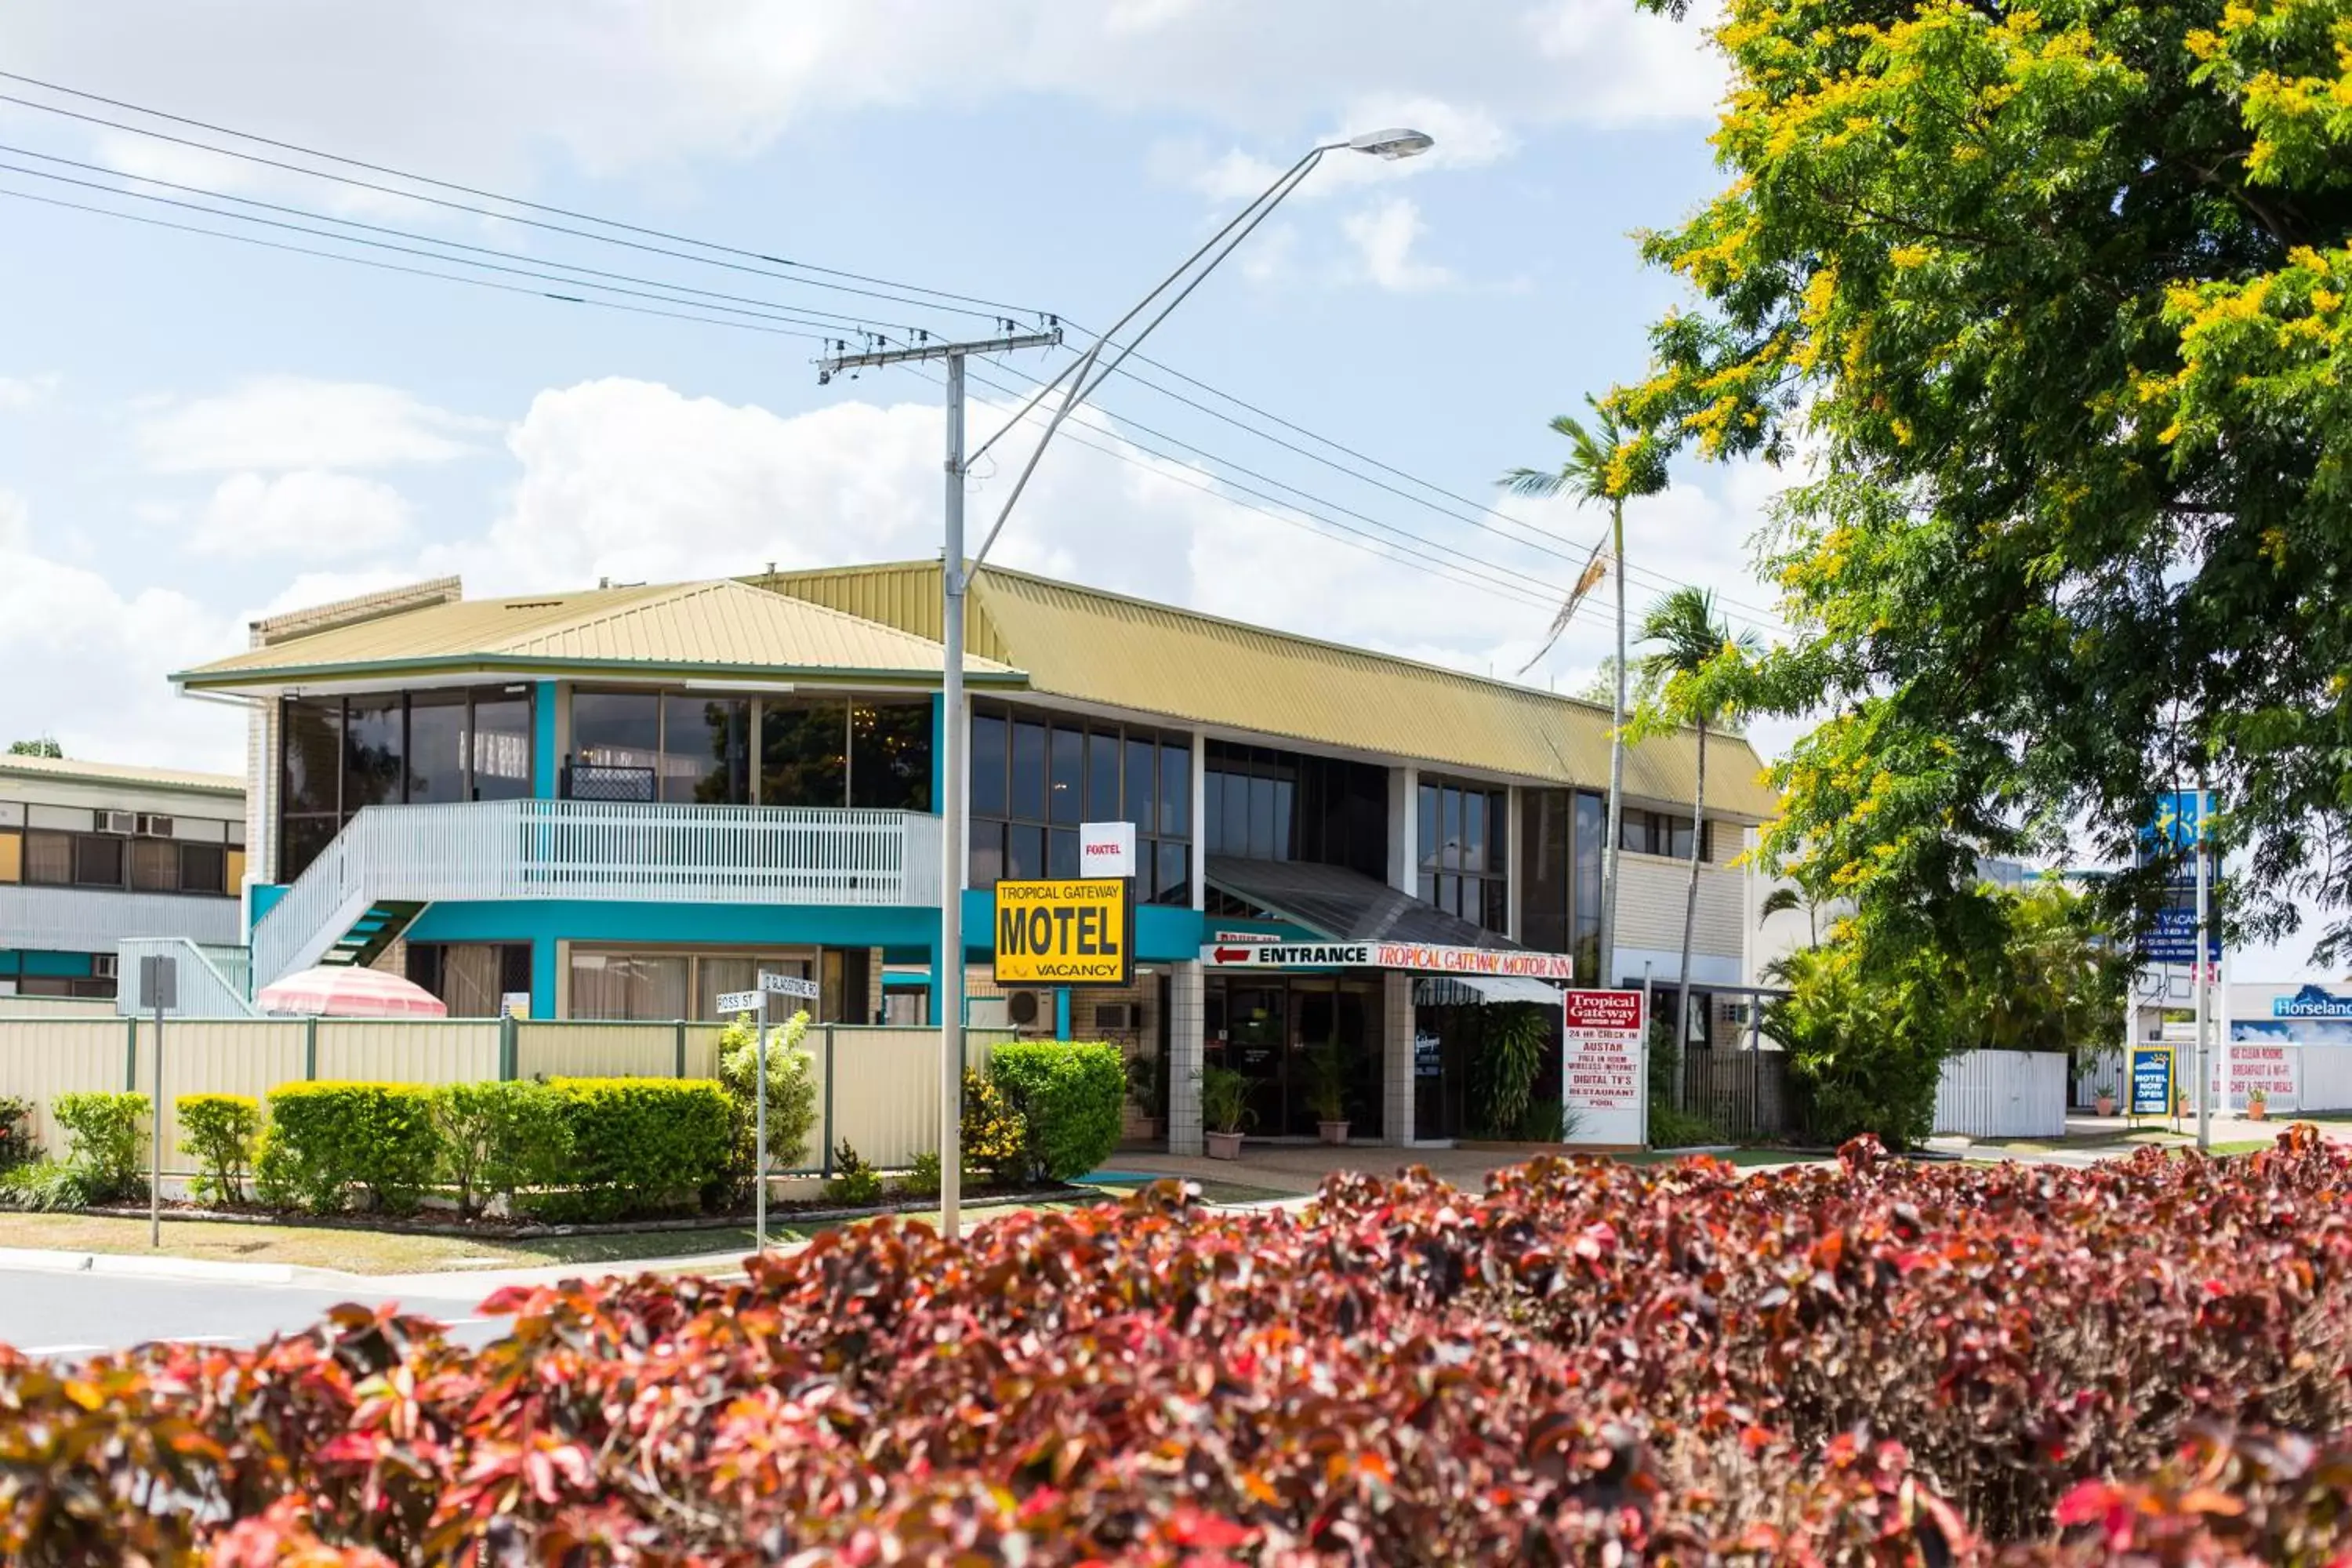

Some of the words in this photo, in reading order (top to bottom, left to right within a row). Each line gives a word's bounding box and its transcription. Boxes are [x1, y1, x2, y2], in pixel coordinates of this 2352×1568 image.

[1086, 844, 1121, 855] FOXTEL
[1000, 887, 1059, 899] TROPICAL
[1063, 886, 1119, 898] GATEWAY
[1000, 906, 1118, 956] MOTEL
[1259, 947, 1367, 963] ENTRANCE
[1378, 946, 1439, 967] TROPICAL
[1445, 952, 1501, 972] GATEWAY
[1503, 955, 1546, 975] MOTOR
[1550, 956, 1570, 975] INN
[1036, 964, 1117, 976] VACANCY
[772, 976, 806, 994] GLADSTONE
[808, 983, 816, 996] RD
[717, 994, 739, 1009] ROSS
[1571, 994, 1635, 1008] Tropical
[1570, 1006, 1637, 1022] Gateway
[1583, 1030, 1594, 1039] HR
[1598, 1030, 1624, 1039] CHECK
[1583, 1042, 1624, 1051] AUSTAR
[2232, 1064, 2265, 1076] BREAKFAST
[1573, 1075, 1607, 1084] DIGITAL
[1569, 1087, 1635, 1097] RESTAURANT
[2230, 1080, 2245, 1092] CHEF
[2273, 1081, 2292, 1092] MEALS
